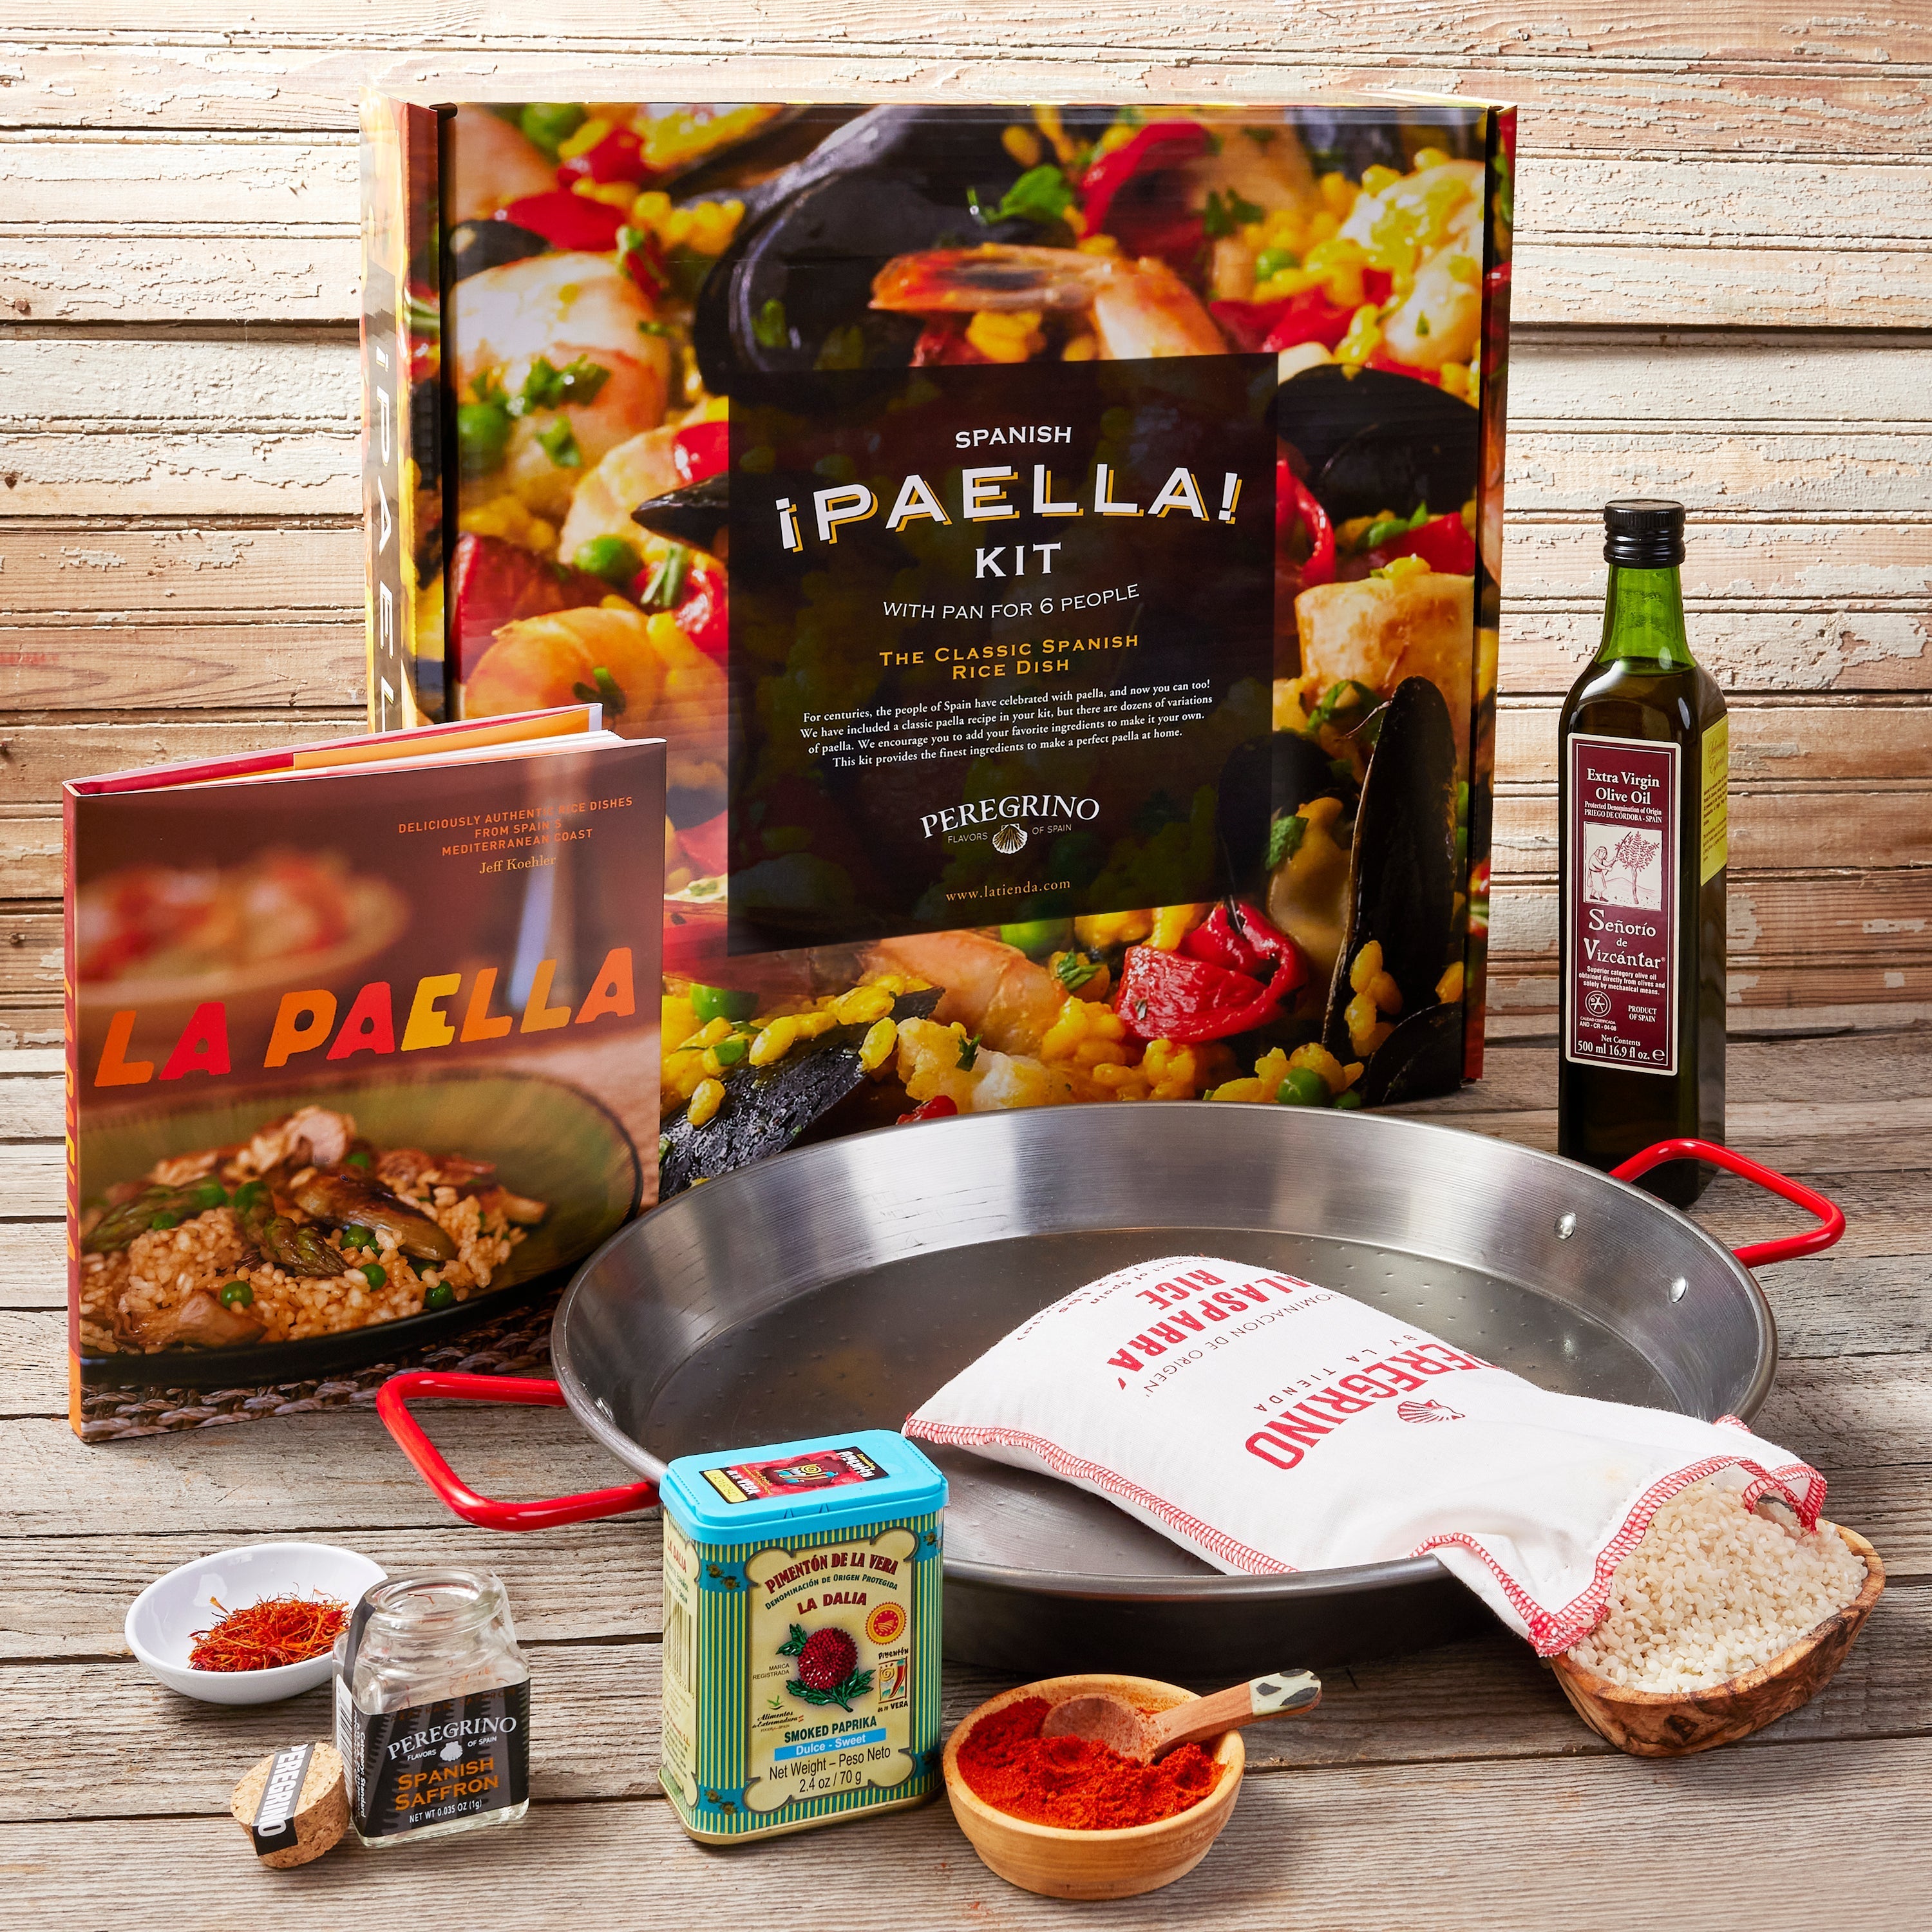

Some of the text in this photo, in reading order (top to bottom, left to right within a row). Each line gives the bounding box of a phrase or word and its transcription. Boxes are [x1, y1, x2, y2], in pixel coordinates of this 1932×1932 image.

[956, 426, 1072, 448] SPANISH
[775, 463, 1243, 553] ¡PAELLA!
[976, 542, 1061, 578] KIT
[884, 583, 1139, 619] WITH PAN FOR 6 PEOPLE
[804, 713, 821, 722] For
[824, 708, 872, 721] centuries,
[876, 706, 892, 716] the
[895, 703, 927, 717] people
[931, 701, 942, 712] of
[944, 700, 971, 713] Spain
[975, 698, 997, 708] have
[999, 692, 1048, 706] celebrated
[1051, 690, 1073, 701] with
[1076, 688, 1106, 703] paella,
[1110, 685, 1127, 696] and
[1153, 685, 1170, 696] you
[1192, 679, 1209, 689] too!
[833, 757, 855, 767] This
[859, 755, 872, 765] kit
[876, 751, 918, 766] provides
[921, 749, 936, 759] the
[940, 748, 967, 757] finest
[971, 743, 1024, 757] ingredients
[1040, 737, 1065, 748] make
[1076, 734, 1108, 748] perfect
[1112, 731, 1139, 745] paella
[1154, 728, 1182, 738] home.
[1587, 768, 1660, 790] Extra Virgin
[1596, 788, 1651, 804] Olive Oil
[398, 797, 633, 834] DELICIOUSLY AUTHENTIC RICE DISHES
[920, 795, 1100, 839] PEREGRINO
[1584, 808, 1605, 817] PRIEGO
[1615, 810, 1642, 821] CÓRDOBA
[1585, 800, 1606, 810] Protected
[1607, 803, 1640, 813] Denomination
[1646, 808, 1662, 817] Origin
[441, 828, 593, 856] MEDITERRANEAN COAST
[475, 825, 509, 839] FROM
[948, 824, 1072, 843] FLAVORS OF SPAIN
[479, 854, 556, 875] Jeff Koehler
[946, 881, 1070, 901] www.latienda.com
[1589, 908, 1656, 937] Señorío
[1616, 938, 1627, 947] de
[1578, 972, 1602, 980] obtained
[1603, 974, 1623, 984] directly
[1587, 965, 1609, 974] Superior
[1611, 970, 1634, 978] category
[1583, 980, 1600, 989] solely
[1607, 983, 1638, 992] mechanical
[94, 947, 637, 1088] LA PAELLA
[1628, 1005, 1657, 1015] PRODUCT
[1638, 1014, 1656, 1023] SPAIN
[1578, 1041, 1650, 1060] 500 ml 16.9 fl oz.
[1601, 1034, 1641, 1046] Net Contents
[1090, 1281, 1132, 1305] Spain
[1135, 1269, 1227, 1311] RICE
[1229, 1293, 1343, 1338] OMINACION
[1205, 1336, 1229, 1350] DE
[1253, 1334, 1418, 1412] BY LA TIENDA
[764, 1552, 898, 1594] PIMENTÓN DE LA VERA
[765, 1578, 819, 1610] DENOMINACIÓN
[862, 1574, 898, 1590] PROTEGIDA
[797, 1591, 867, 1615] LA DALIA
[752, 1669, 790, 1680] REGISTRADA
[757, 1711, 793, 1721] Alimentos
[890, 1700, 909, 1710] VERA
[757, 1717, 798, 1727] Extremadura
[784, 1716, 876, 1743] SMOKED PAPRIKA
[387, 1716, 517, 1761] PEREGRINO
[407, 1749, 437, 1762] FLAVORS
[478, 1736, 497, 1745] SPAIN
[796, 1743, 826, 1756] Dulce
[835, 1734, 866, 1748] Sweet
[397, 1757, 495, 1792] SPANISH
[770, 1765, 788, 1780] Net
[791, 1757, 826, 1776] Weight
[839, 1753, 864, 1767] Peso
[867, 1746, 891, 1761] Neto
[799, 1770, 861, 1793] 2.4 oz / 70 g
[394, 1775, 499, 1812] SAFFRON
[410, 1799, 482, 1823] NET WT 0.035 OZ (1g)
